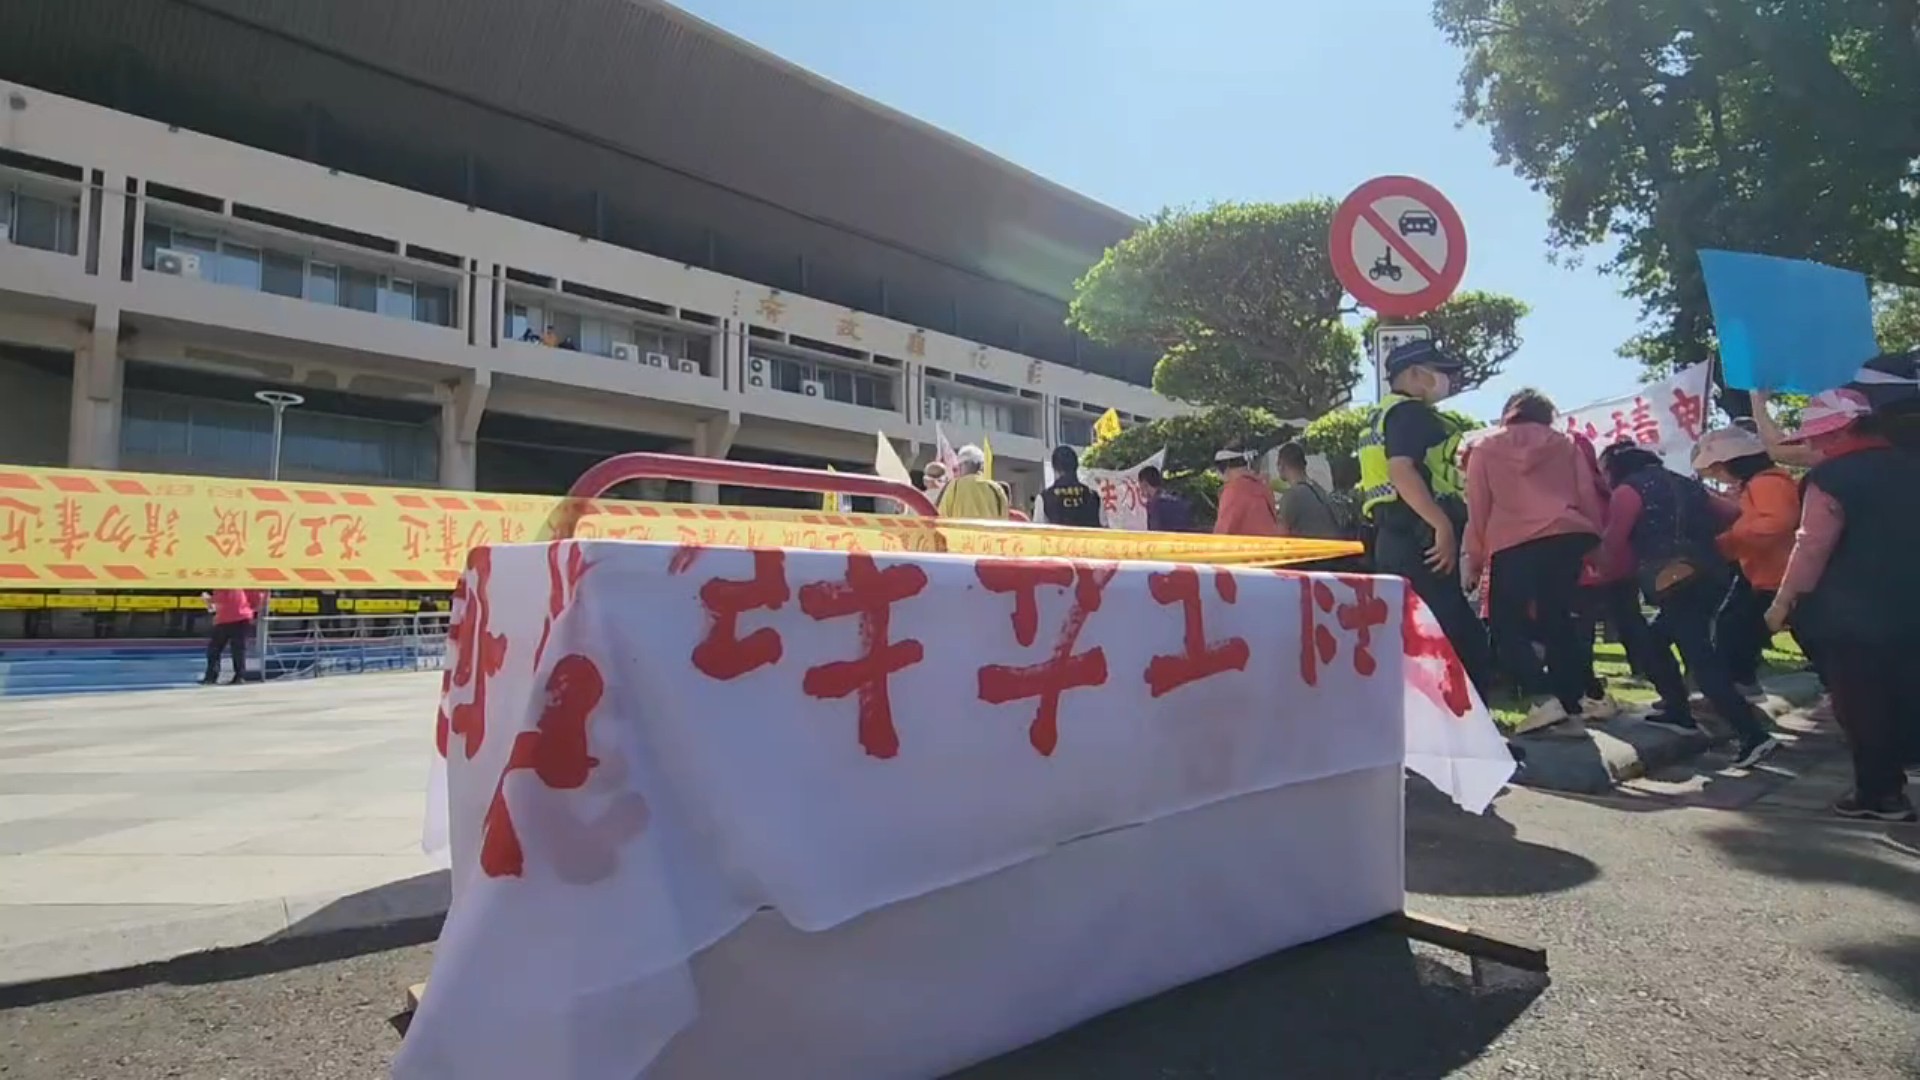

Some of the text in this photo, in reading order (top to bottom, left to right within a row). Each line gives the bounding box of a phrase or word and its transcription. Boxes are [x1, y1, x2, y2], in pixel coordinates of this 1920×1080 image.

[0, 495, 181, 560] 請勿靠近
[205, 505, 369, 560] 施工危險
